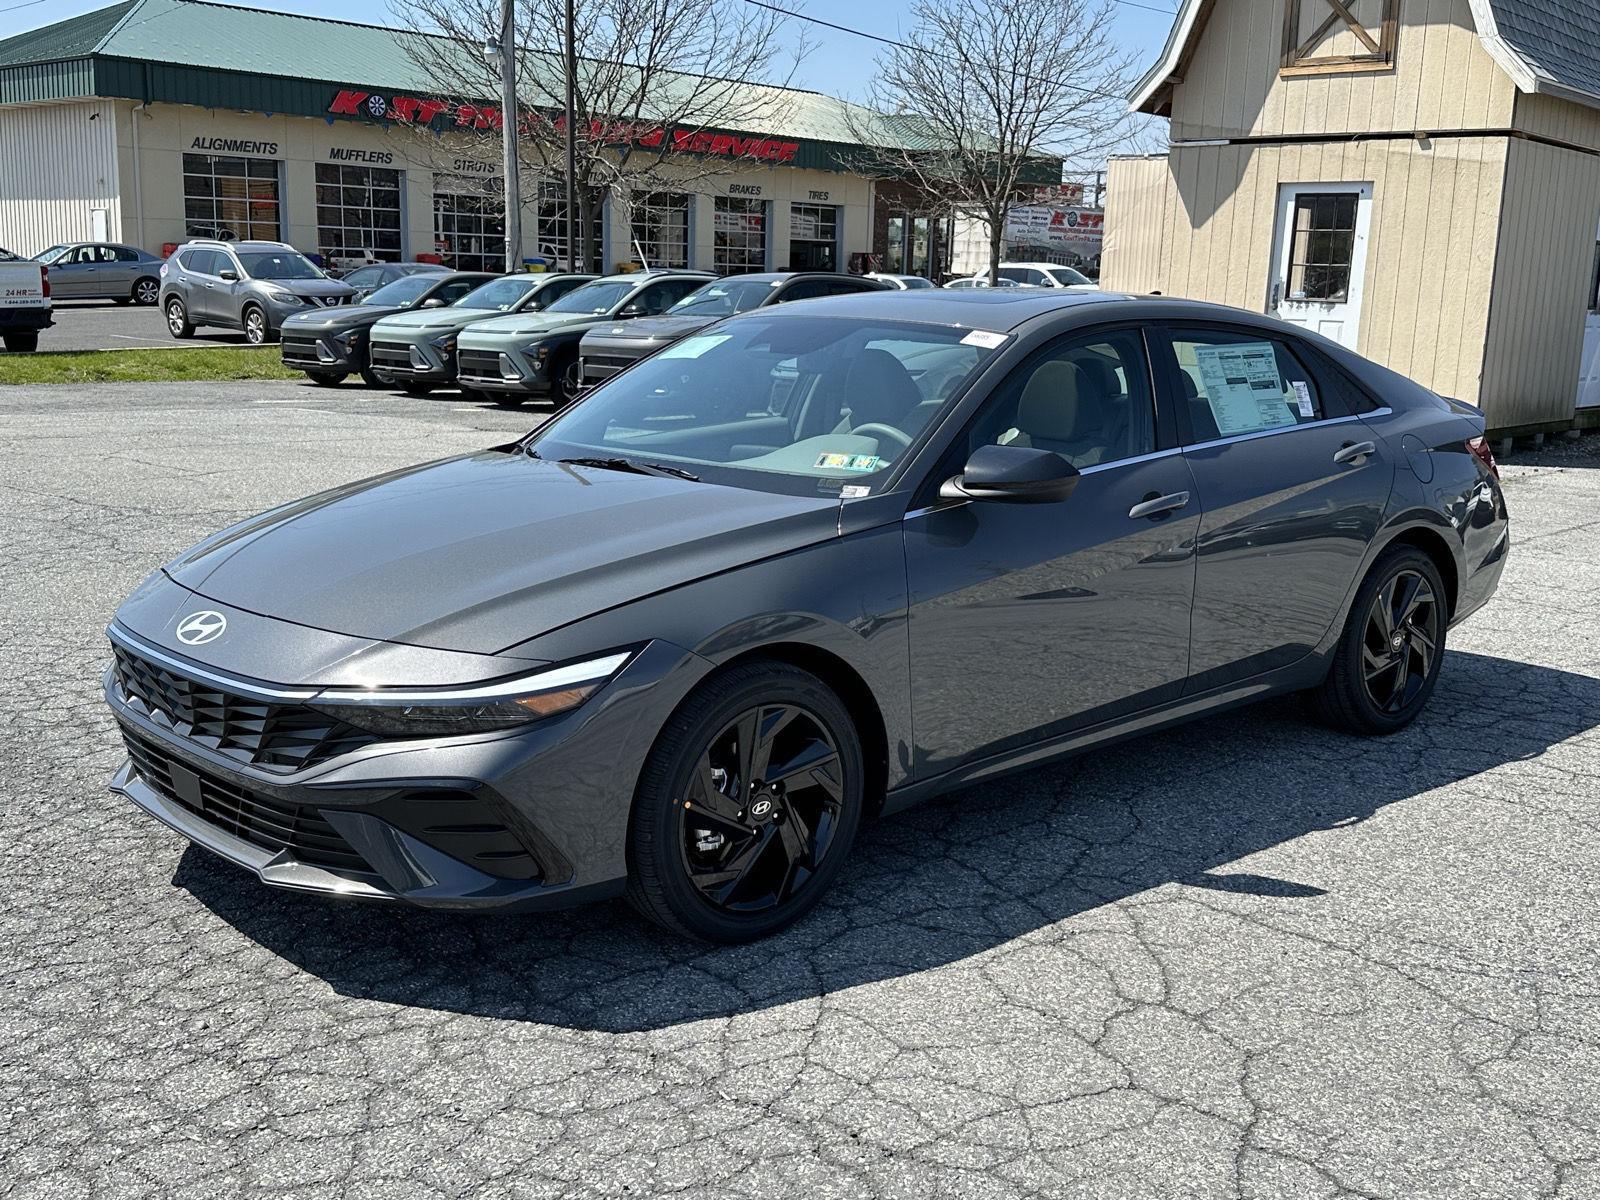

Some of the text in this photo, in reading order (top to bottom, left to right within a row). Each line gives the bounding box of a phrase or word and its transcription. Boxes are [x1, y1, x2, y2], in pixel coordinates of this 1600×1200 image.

[191, 136, 278, 155] ALIGNMENTS
[673, 129, 800, 160] SERVICE
[329, 147, 393, 164] MUFFLERS
[729, 183, 762, 196] BRAKES
[808, 190, 830, 200] TIRES
